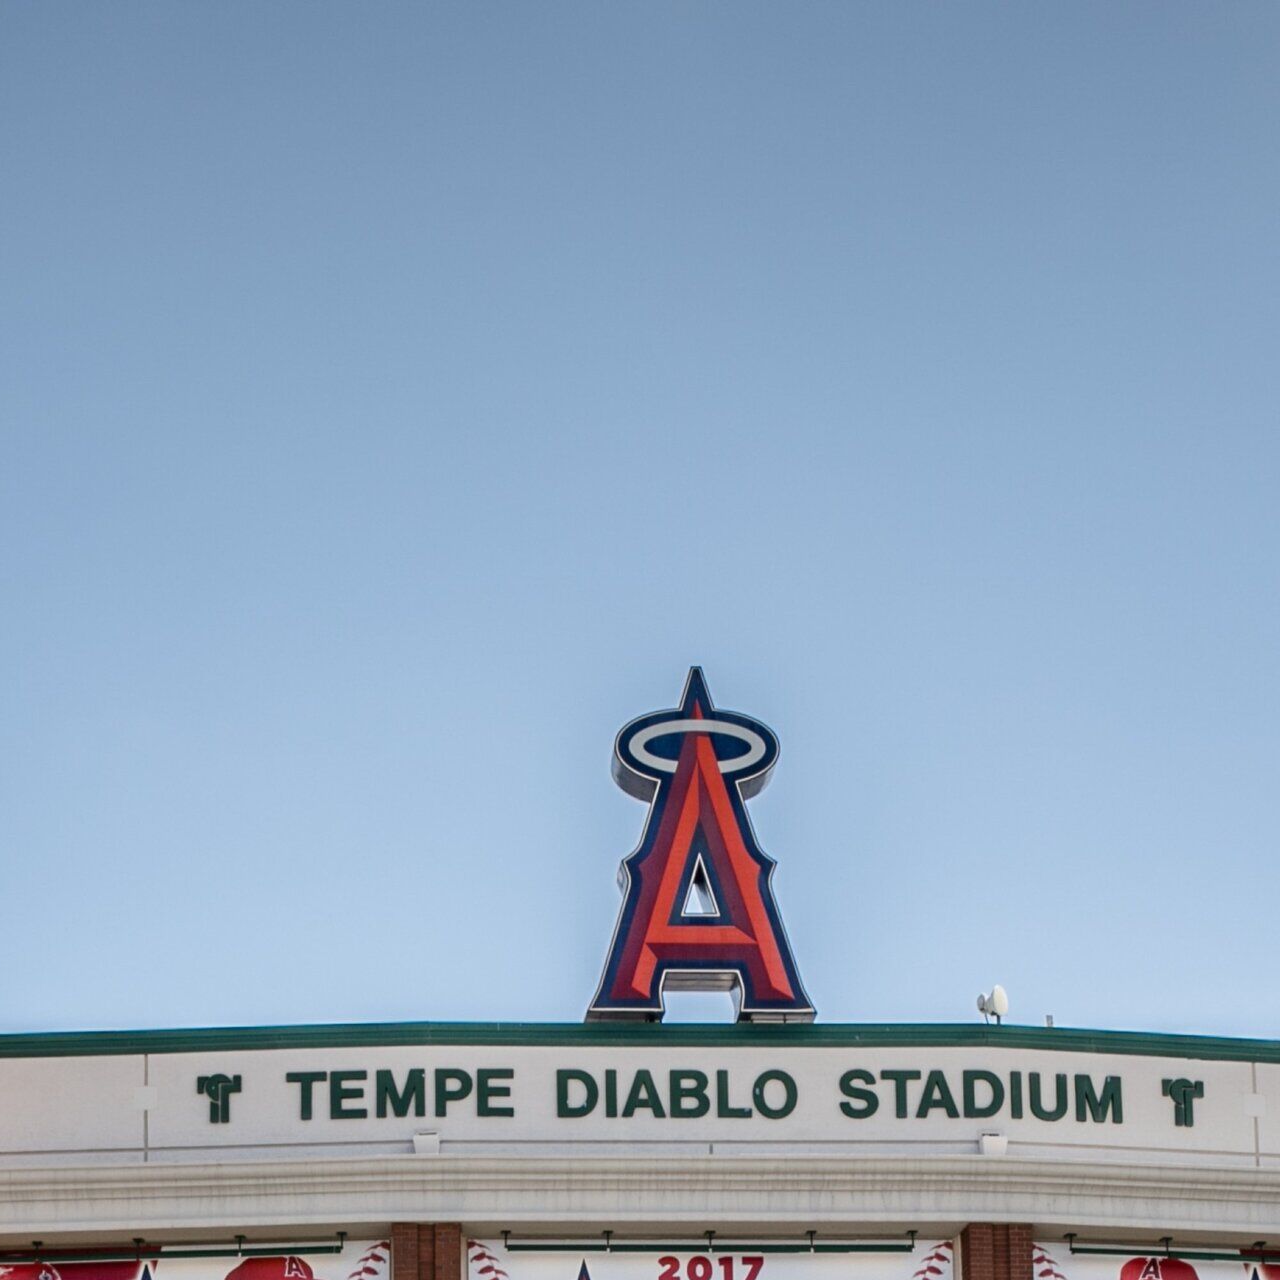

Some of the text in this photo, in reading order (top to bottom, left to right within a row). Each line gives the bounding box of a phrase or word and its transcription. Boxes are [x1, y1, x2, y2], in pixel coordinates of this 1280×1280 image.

[286, 1068, 515, 1121] TEMPE
[556, 1068, 798, 1118] DIABLO
[839, 1068, 1124, 1125] STADIUM
